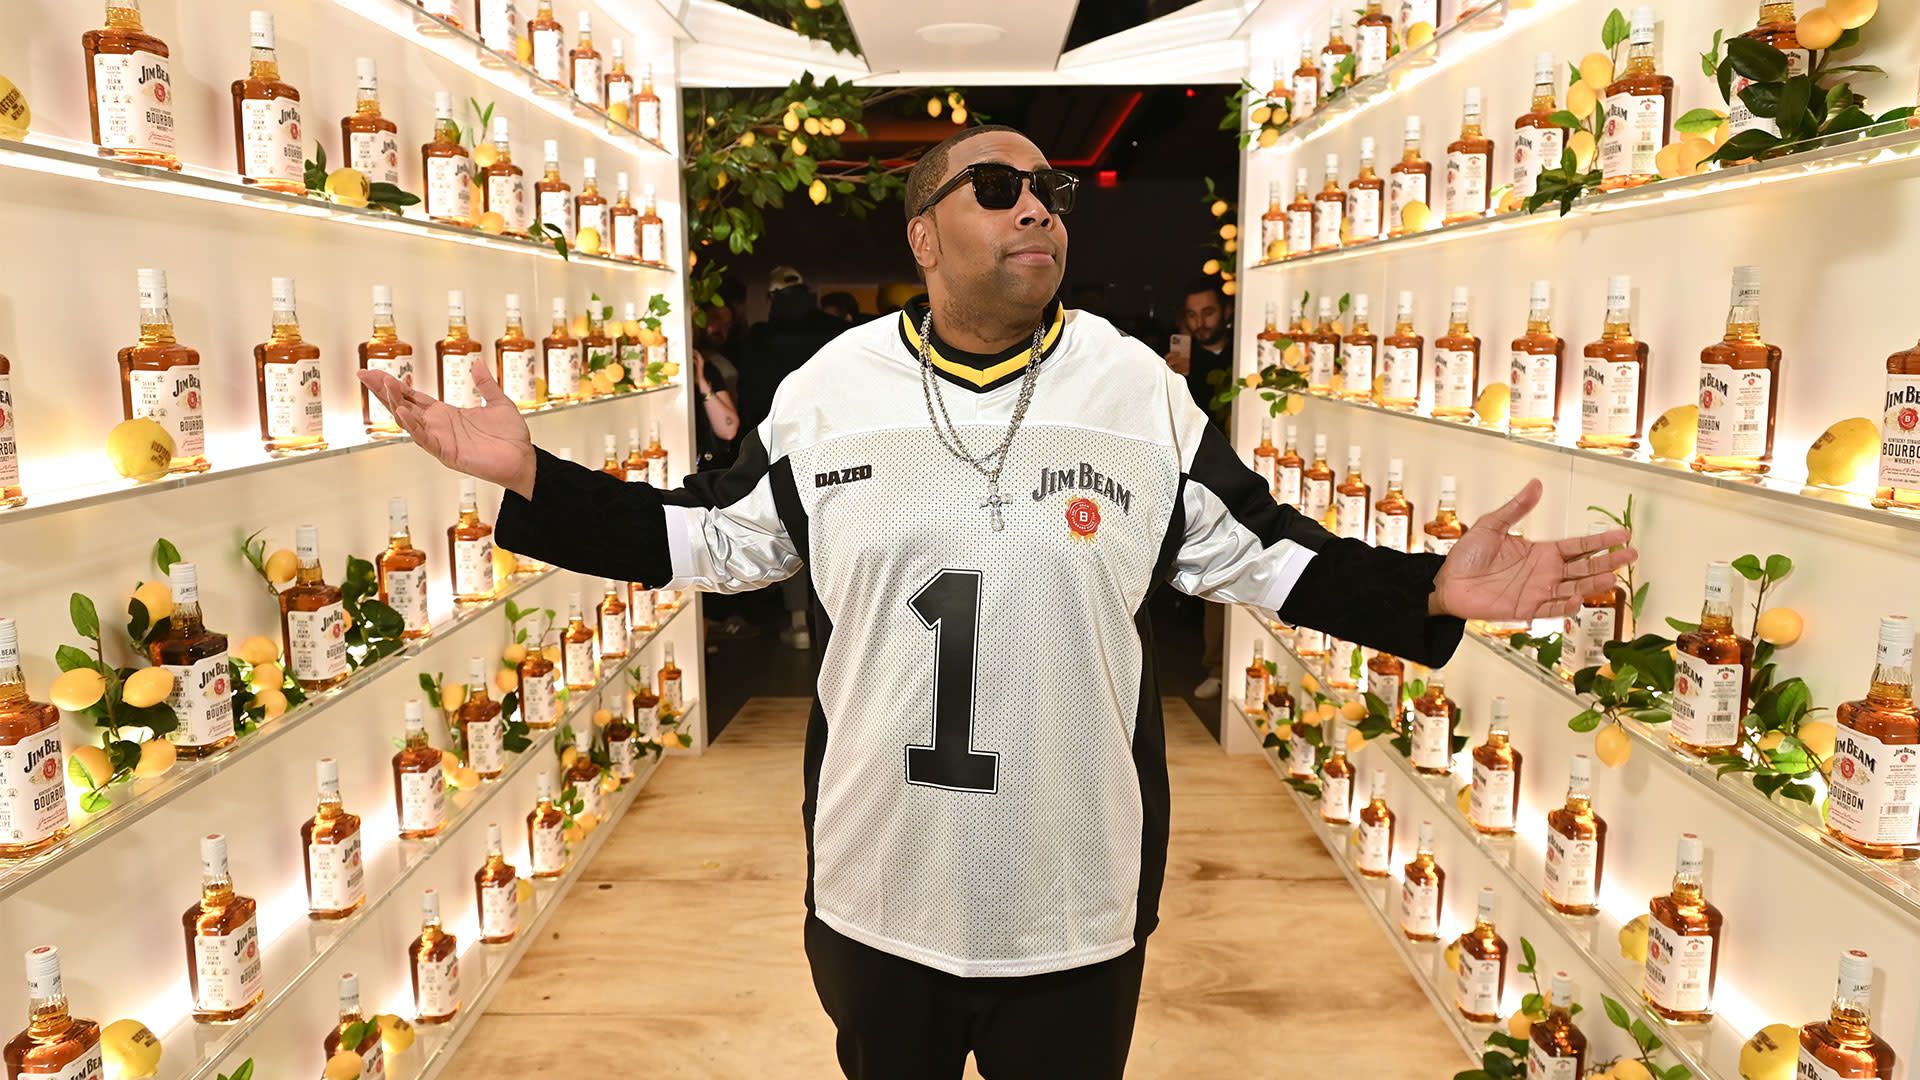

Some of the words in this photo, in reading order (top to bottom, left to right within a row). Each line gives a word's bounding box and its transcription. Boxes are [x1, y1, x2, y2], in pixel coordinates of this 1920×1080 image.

[138, 65, 156, 85] JIM
[156, 63, 170, 84] BEA
[173, 379, 189, 397] JIM
[1706, 372, 1728, 396] BEAM
[1885, 390, 1903, 412] JIM
[1905, 385, 1920, 404] BE
[815, 464, 872, 488] DAZED
[1032, 467, 1076, 502] JIM
[1078, 462, 1130, 516] BEAM
[1080, 511, 1088, 522] B
[199, 668, 215, 689] JIM
[215, 662, 229, 676] BEA
[905, 568, 1000, 795] 1
[1683, 661, 1703, 689] BEAM
[206, 701, 231, 720] BOURBO
[24, 744, 46, 774] JIM
[45, 739, 61, 755] BEA
[1836, 738, 1846, 753] IM
[1847, 738, 1876, 774] BEAM
[234, 937, 248, 956] JIM
[1655, 928, 1673, 957] BEAM
[87, 1057, 102, 1074] BEA
[1798, 1061, 1807, 1073] IM
